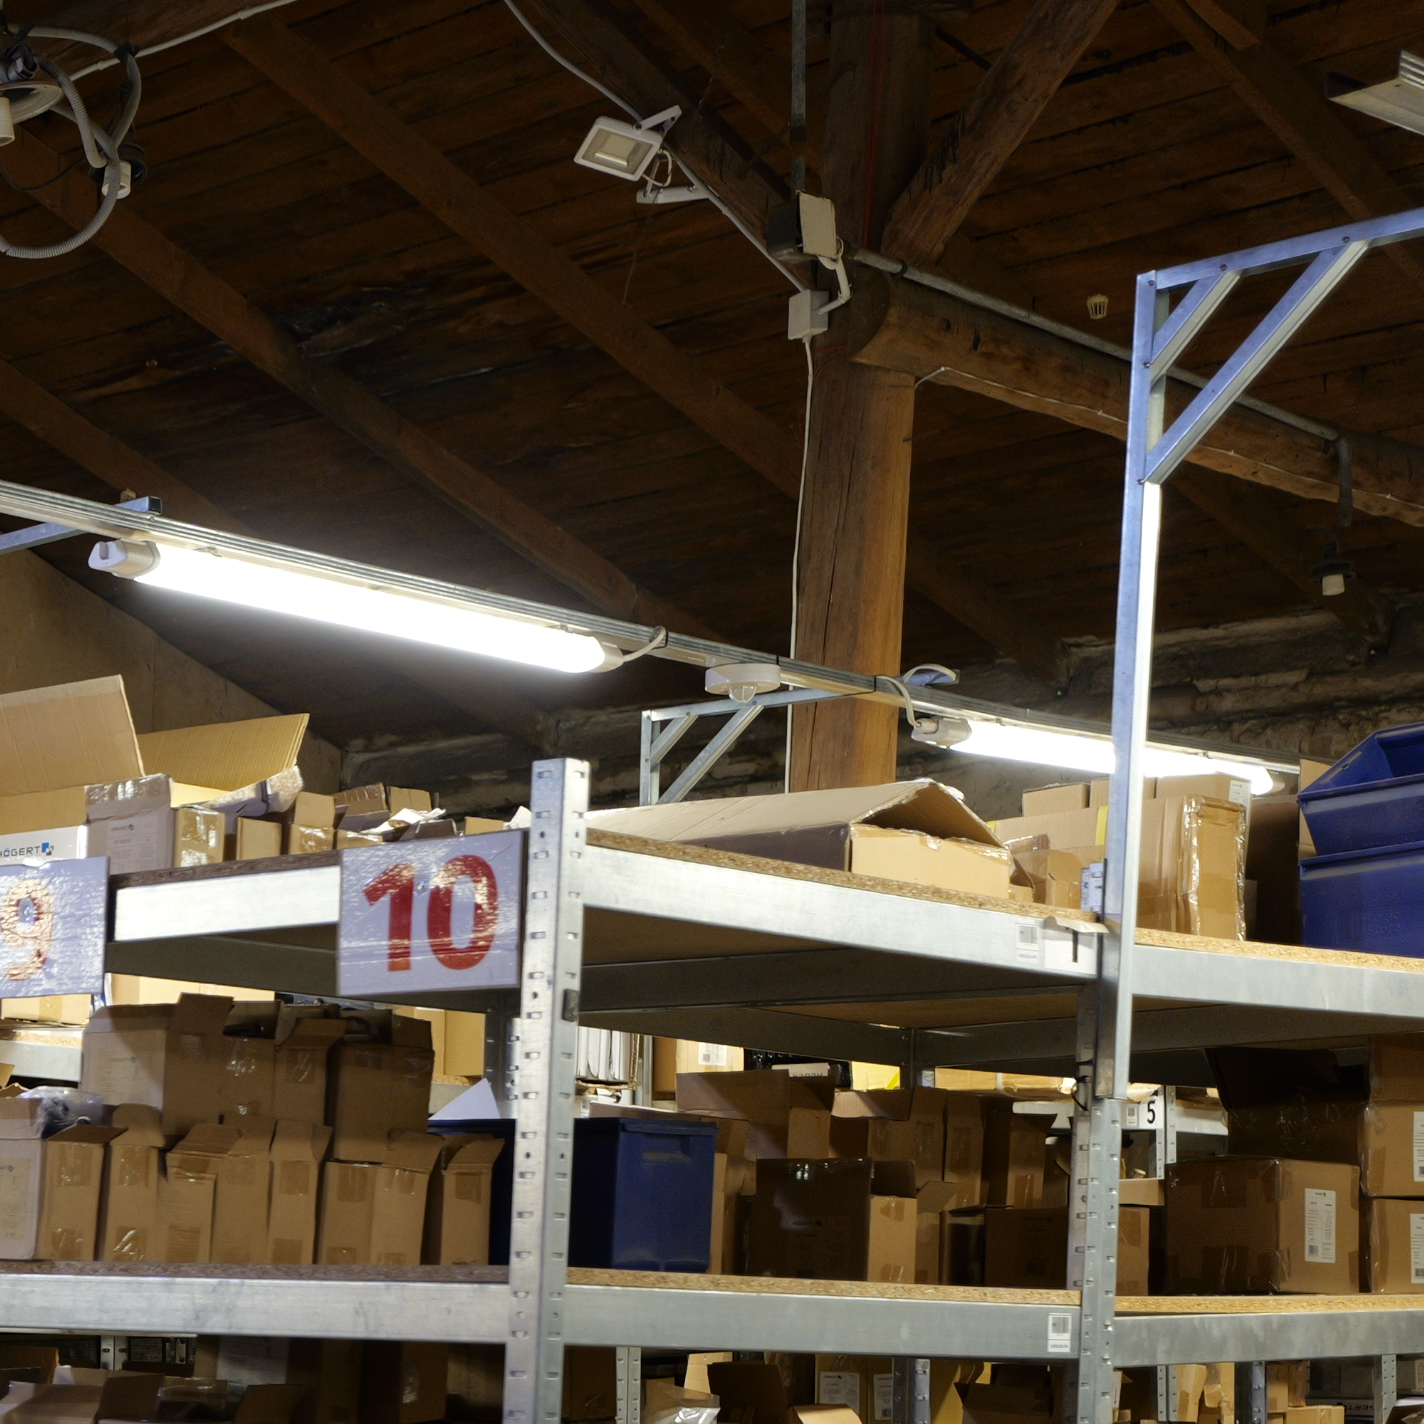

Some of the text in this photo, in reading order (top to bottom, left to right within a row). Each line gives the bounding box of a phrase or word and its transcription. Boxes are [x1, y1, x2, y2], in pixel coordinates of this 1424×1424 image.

[0, 877, 53, 981] 9
[363, 853, 499, 972] 10
[1146, 1101, 1156, 1124] 5
